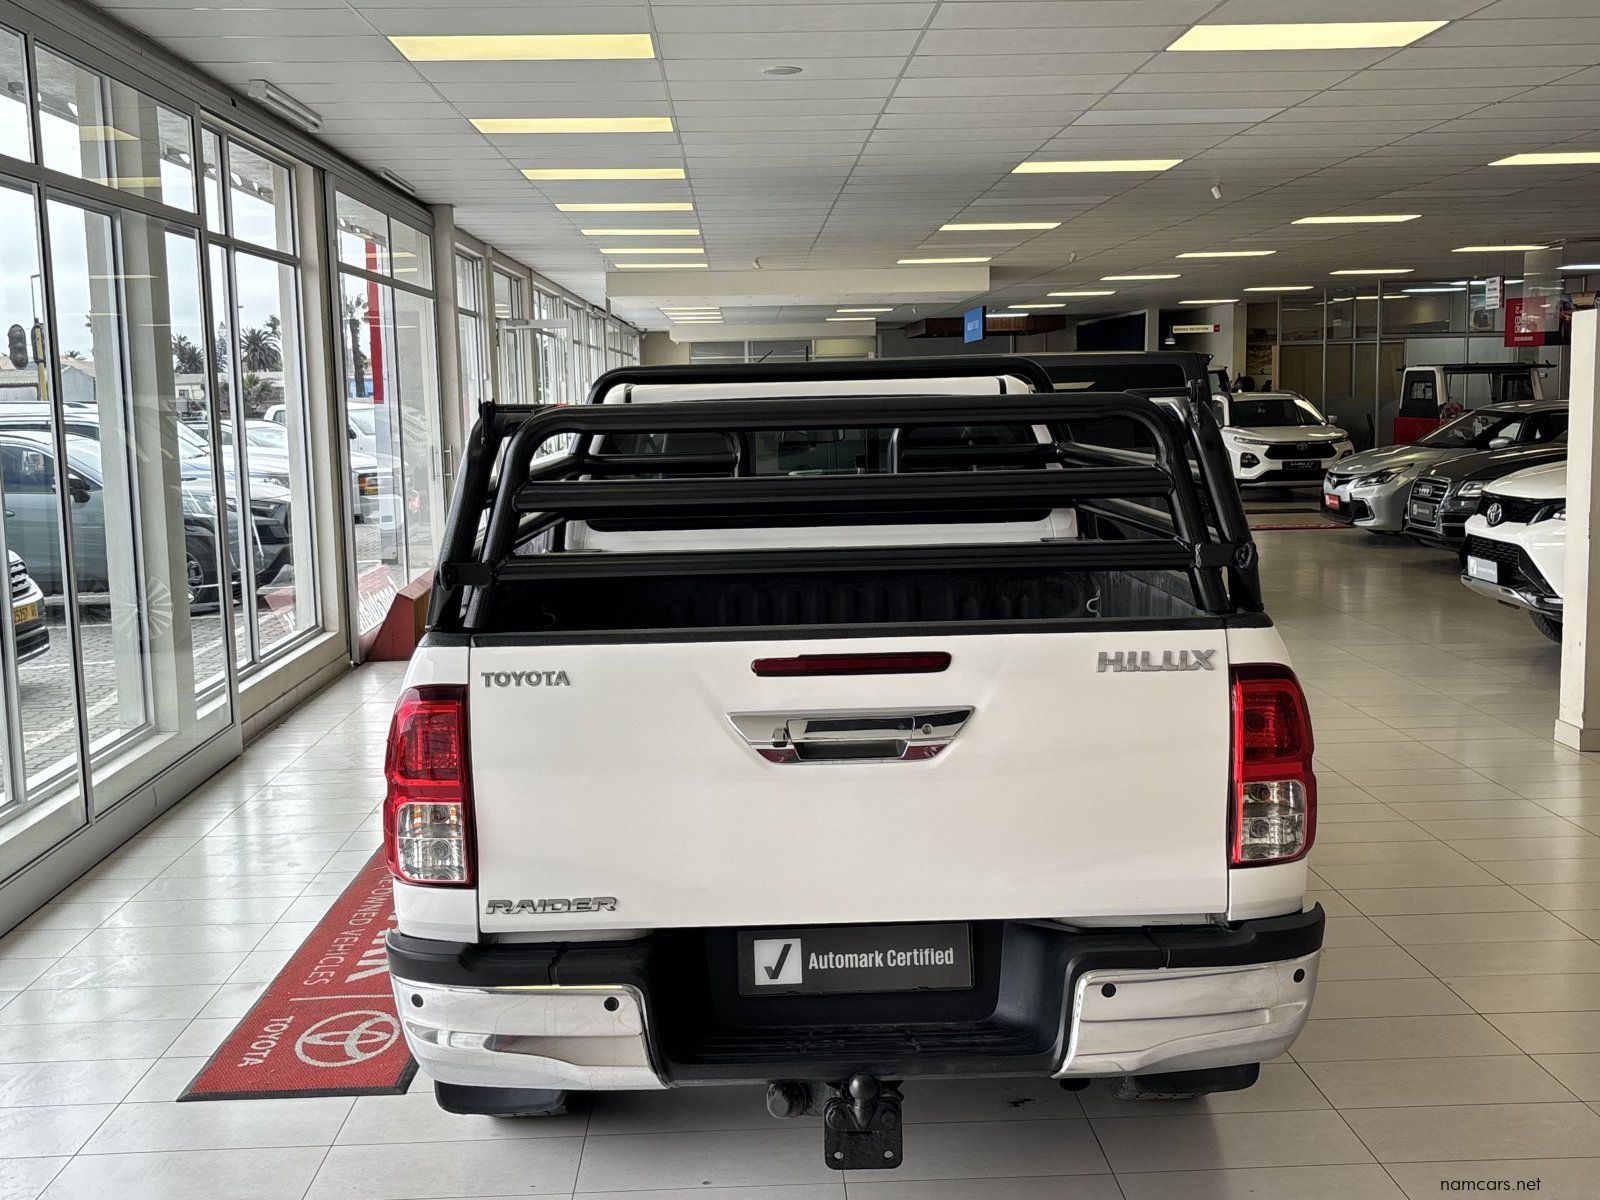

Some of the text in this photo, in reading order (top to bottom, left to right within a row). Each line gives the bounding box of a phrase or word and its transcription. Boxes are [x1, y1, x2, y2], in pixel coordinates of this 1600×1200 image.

[1096, 649, 1216, 672] HILUX
[481, 670, 571, 688] TOYOTA
[485, 896, 618, 915] RAIDER
[303, 929, 365, 986] VEHICLES
[808, 947, 955, 970] Automark Certified
[237, 1015, 295, 1068] TOYOTA
